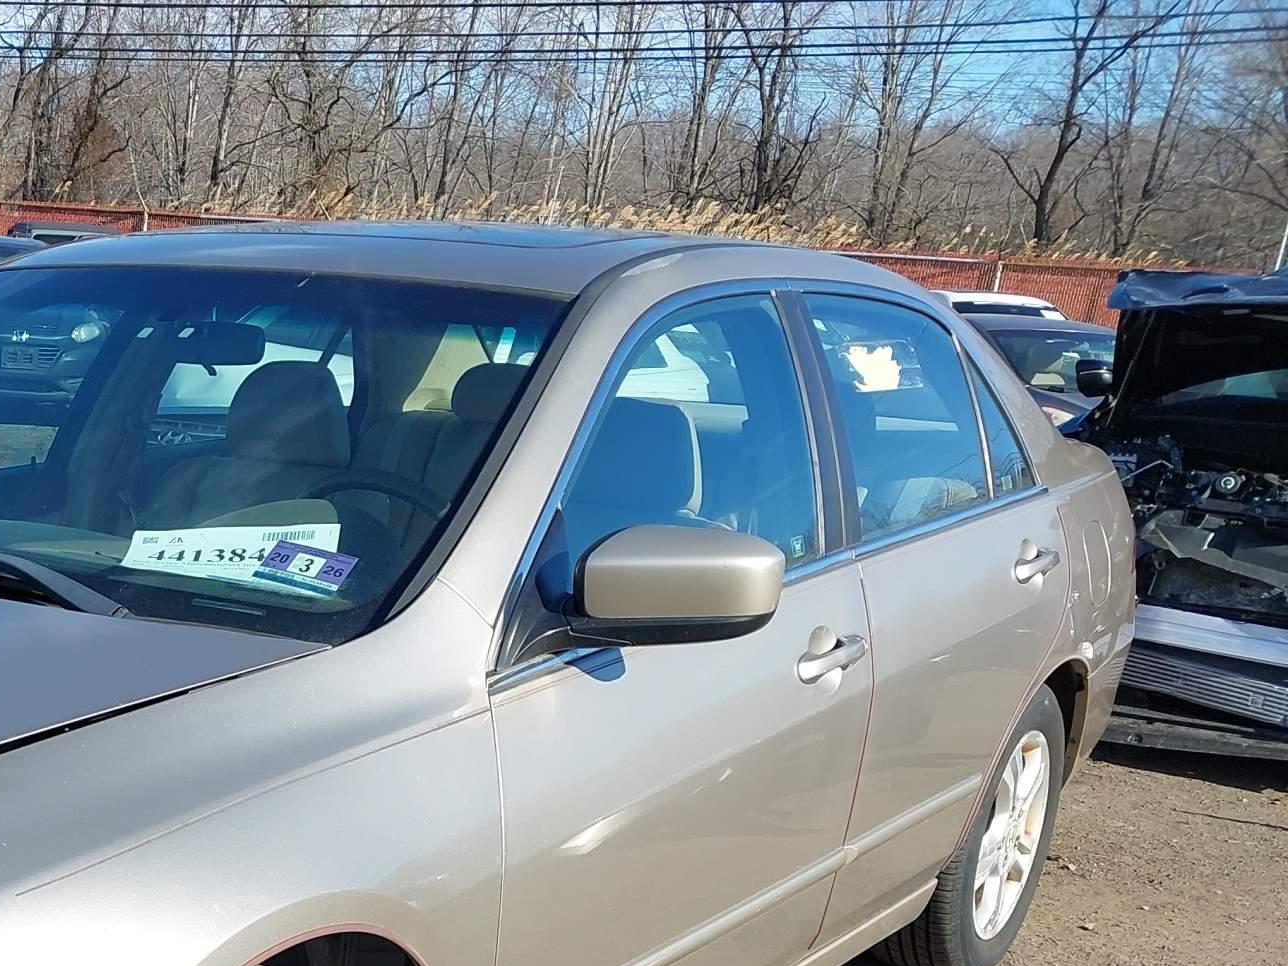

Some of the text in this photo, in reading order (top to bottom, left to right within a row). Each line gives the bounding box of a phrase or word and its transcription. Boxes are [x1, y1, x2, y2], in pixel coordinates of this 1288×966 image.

[270, 551, 290, 564] 20
[298, 558, 315, 573] 3
[322, 565, 345, 578] 26
